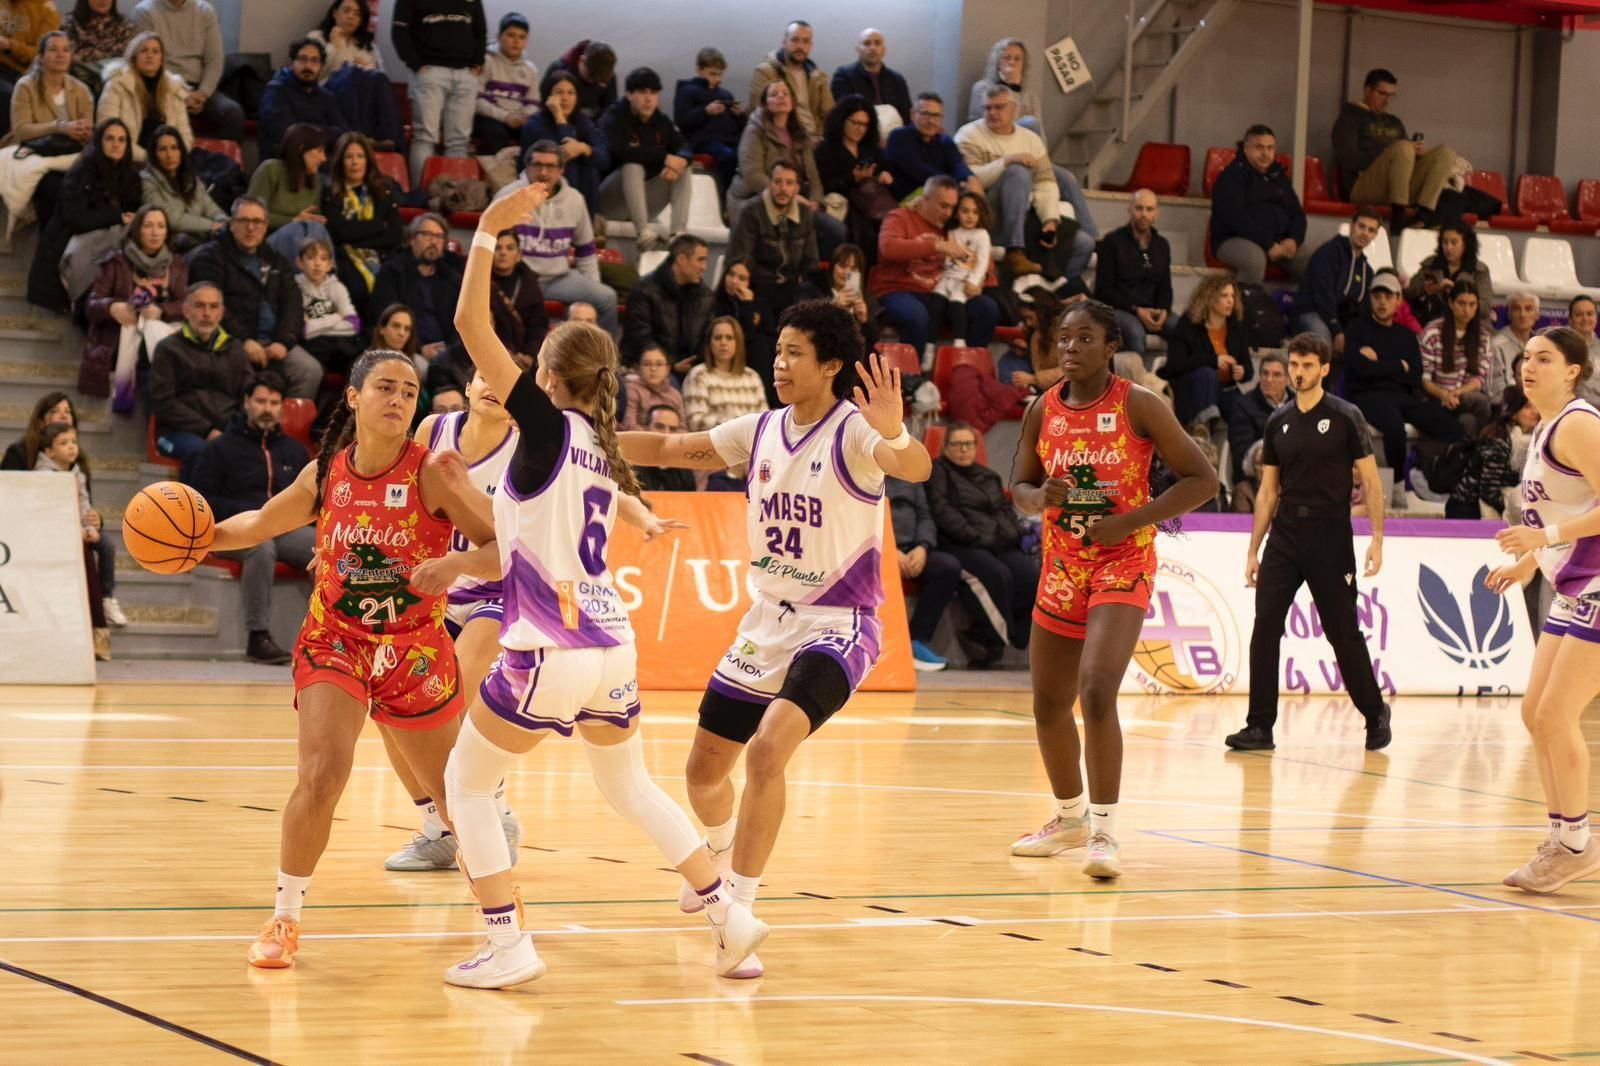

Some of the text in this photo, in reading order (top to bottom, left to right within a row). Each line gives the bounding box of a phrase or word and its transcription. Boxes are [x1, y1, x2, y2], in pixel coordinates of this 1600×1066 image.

[1050, 48, 1075, 86] PASAR
[1065, 52, 1081, 70] NO
[1046, 447, 1122, 476] Móstoles
[322, 522, 411, 551] Móstoles
[578, 485, 613, 577] 6
[765, 526, 804, 560] 24
[780, 564, 825, 583] Plantel
[358, 595, 398, 626] 21
